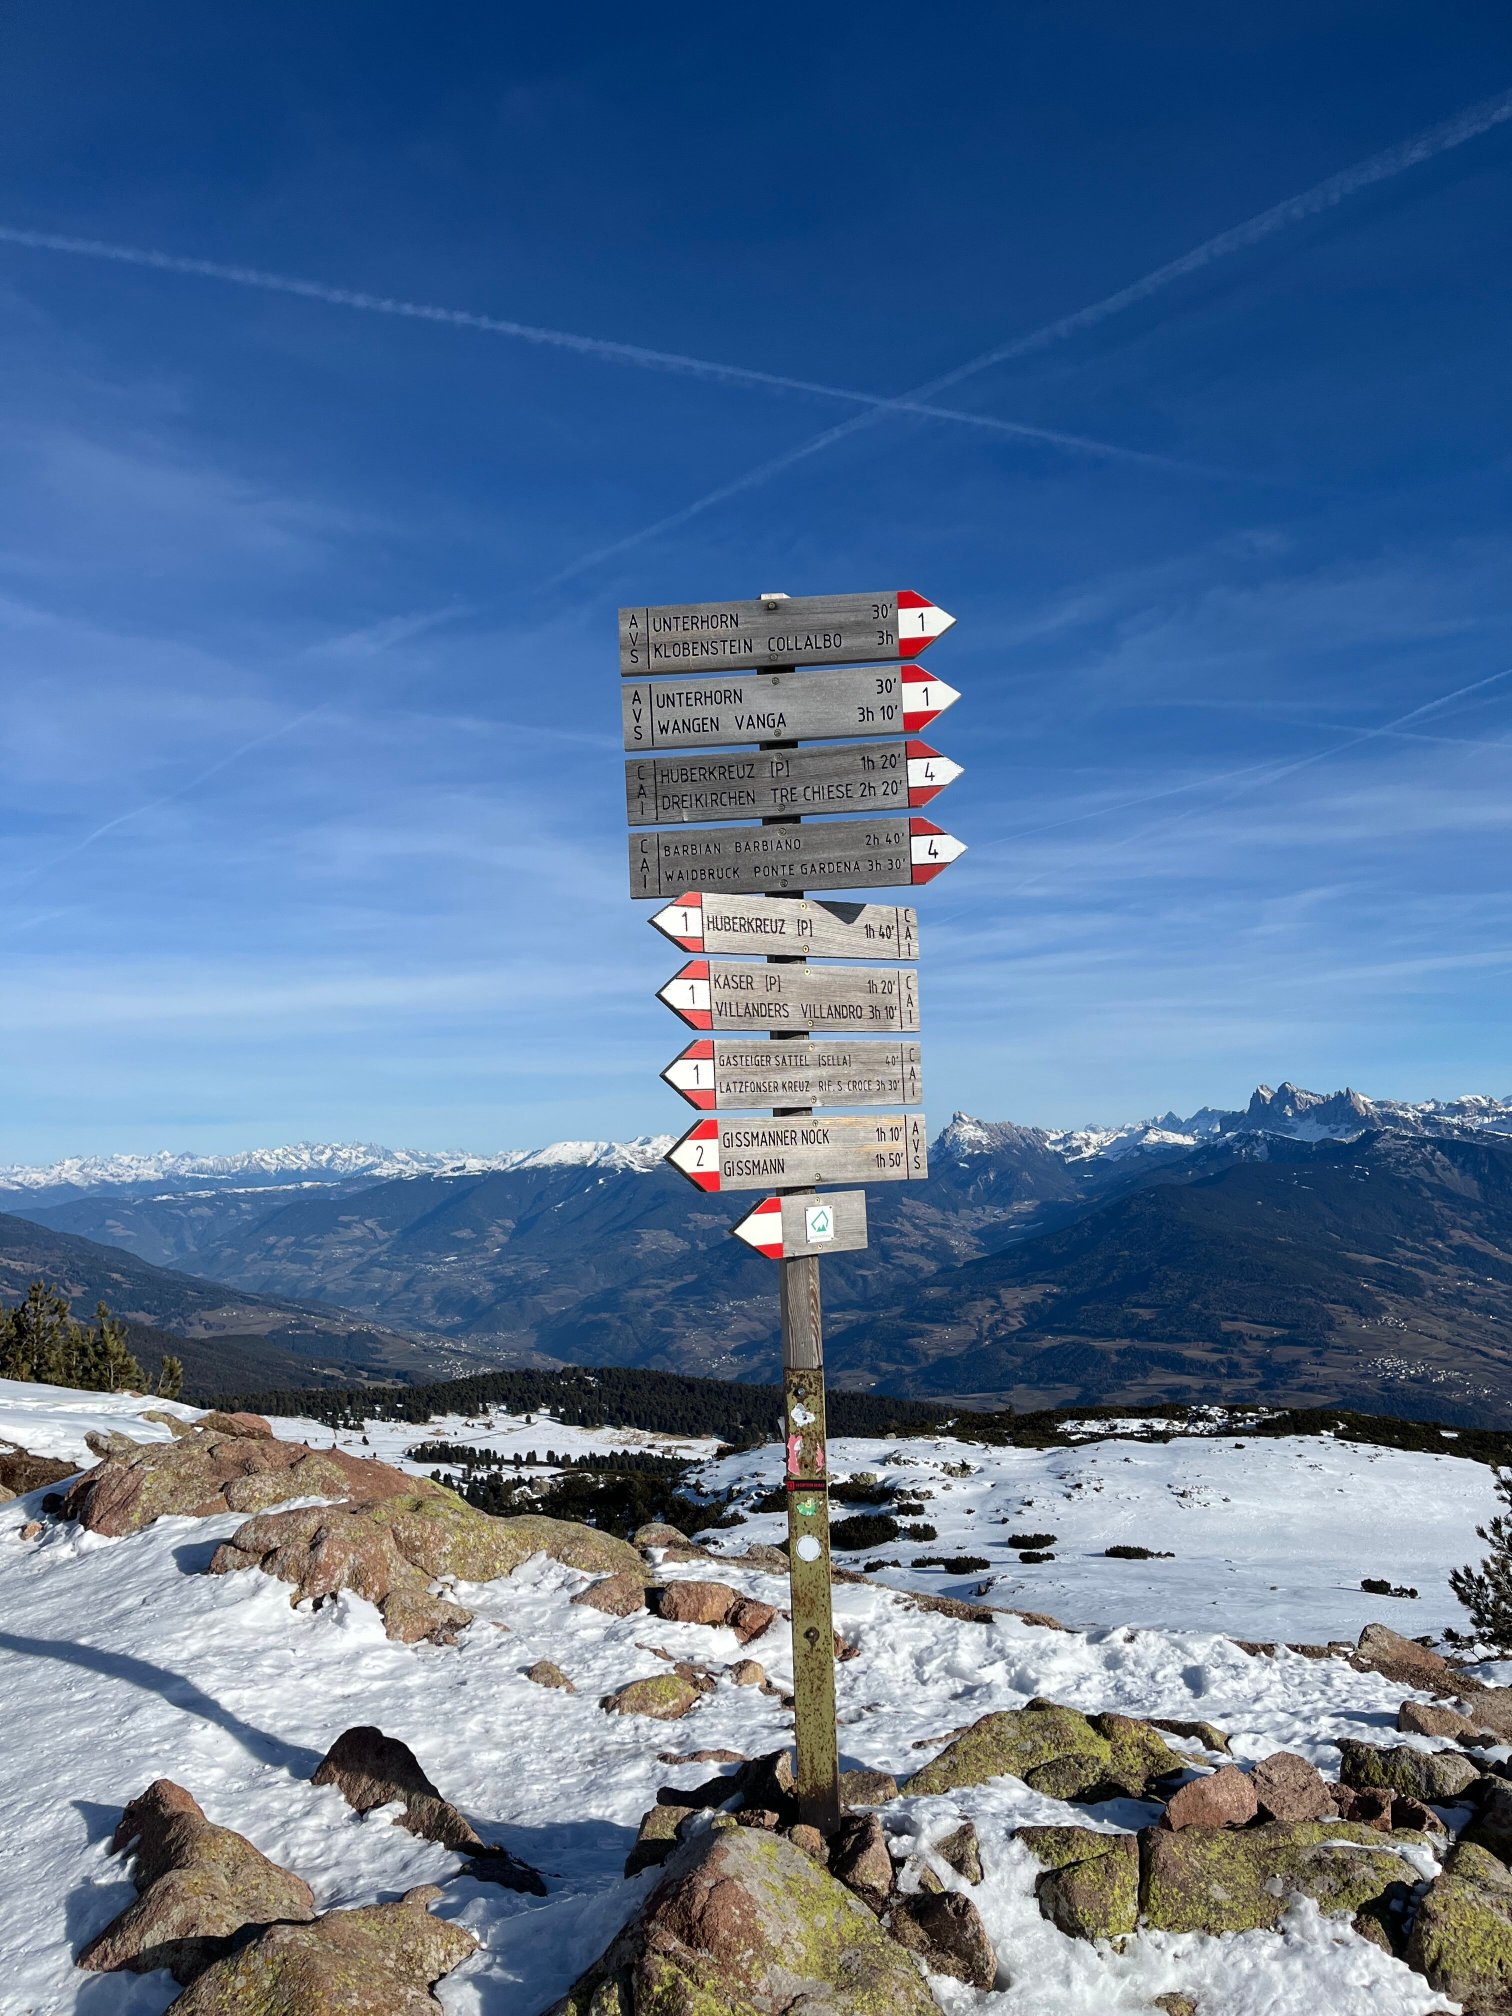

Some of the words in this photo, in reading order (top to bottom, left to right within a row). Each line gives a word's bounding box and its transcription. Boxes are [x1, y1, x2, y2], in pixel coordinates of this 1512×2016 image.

[653, 613, 739, 632] UNTERHORN
[918, 612, 925, 632] 1
[654, 638, 753, 658] KLOBENSTEIN
[768, 633, 842, 652] COLLALBO
[877, 630, 894, 645] 3h
[656, 689, 743, 708] UNTERHORN
[923, 687, 930, 706] 1
[657, 717, 719, 735] WANGEN
[735, 713, 786, 730] VANGA
[858, 706, 874, 722] 3h
[661, 763, 755, 784] HUBERKREUZ
[860, 755, 876, 771] 1h
[924, 762, 935, 781] 4
[662, 790, 756, 810] DREIKIRCHEN
[771, 786, 798, 803] TRE
[803, 784, 853, 801] CHIESE
[859, 782, 876, 797] 2h
[664, 843, 721, 857] BARBIAN
[735, 838, 801, 853] BARBIANO
[865, 832, 880, 846] 2h
[928, 840, 939, 858] 4
[665, 866, 740, 882] WAIDBRUCK
[754, 864, 794, 878] PONTE
[800, 860, 861, 875] GARDENA
[867, 859, 882, 872] 3h
[681, 911, 688, 932] 1
[707, 915, 786, 935] HUBERKREUZ
[864, 923, 875, 938] 1h
[689, 984, 695, 1005] 1
[713, 974, 754, 990] KASER
[867, 980, 878, 994] 1h
[715, 1001, 790, 1018] VILLANDERS
[800, 1003, 863, 1019] VILLANDRO
[868, 1004, 881, 1019] 3h
[719, 1055, 772, 1067] GASTEIGER
[774, 1055, 810, 1067] SATTEL
[693, 1064, 700, 1085] 1
[720, 1081, 779, 1093] LATZFONSER
[781, 1080, 810, 1093] KREUZ
[847, 1080, 872, 1092] CROCE
[876, 1080, 886, 1091] 3h
[722, 1129, 798, 1149] GISSMANNER
[800, 1128, 830, 1146] NOCK
[875, 1128, 886, 1142] 1h
[695, 1145, 704, 1167] 2
[723, 1158, 785, 1177] GISSMANN
[875, 1155, 886, 1168] 1h
